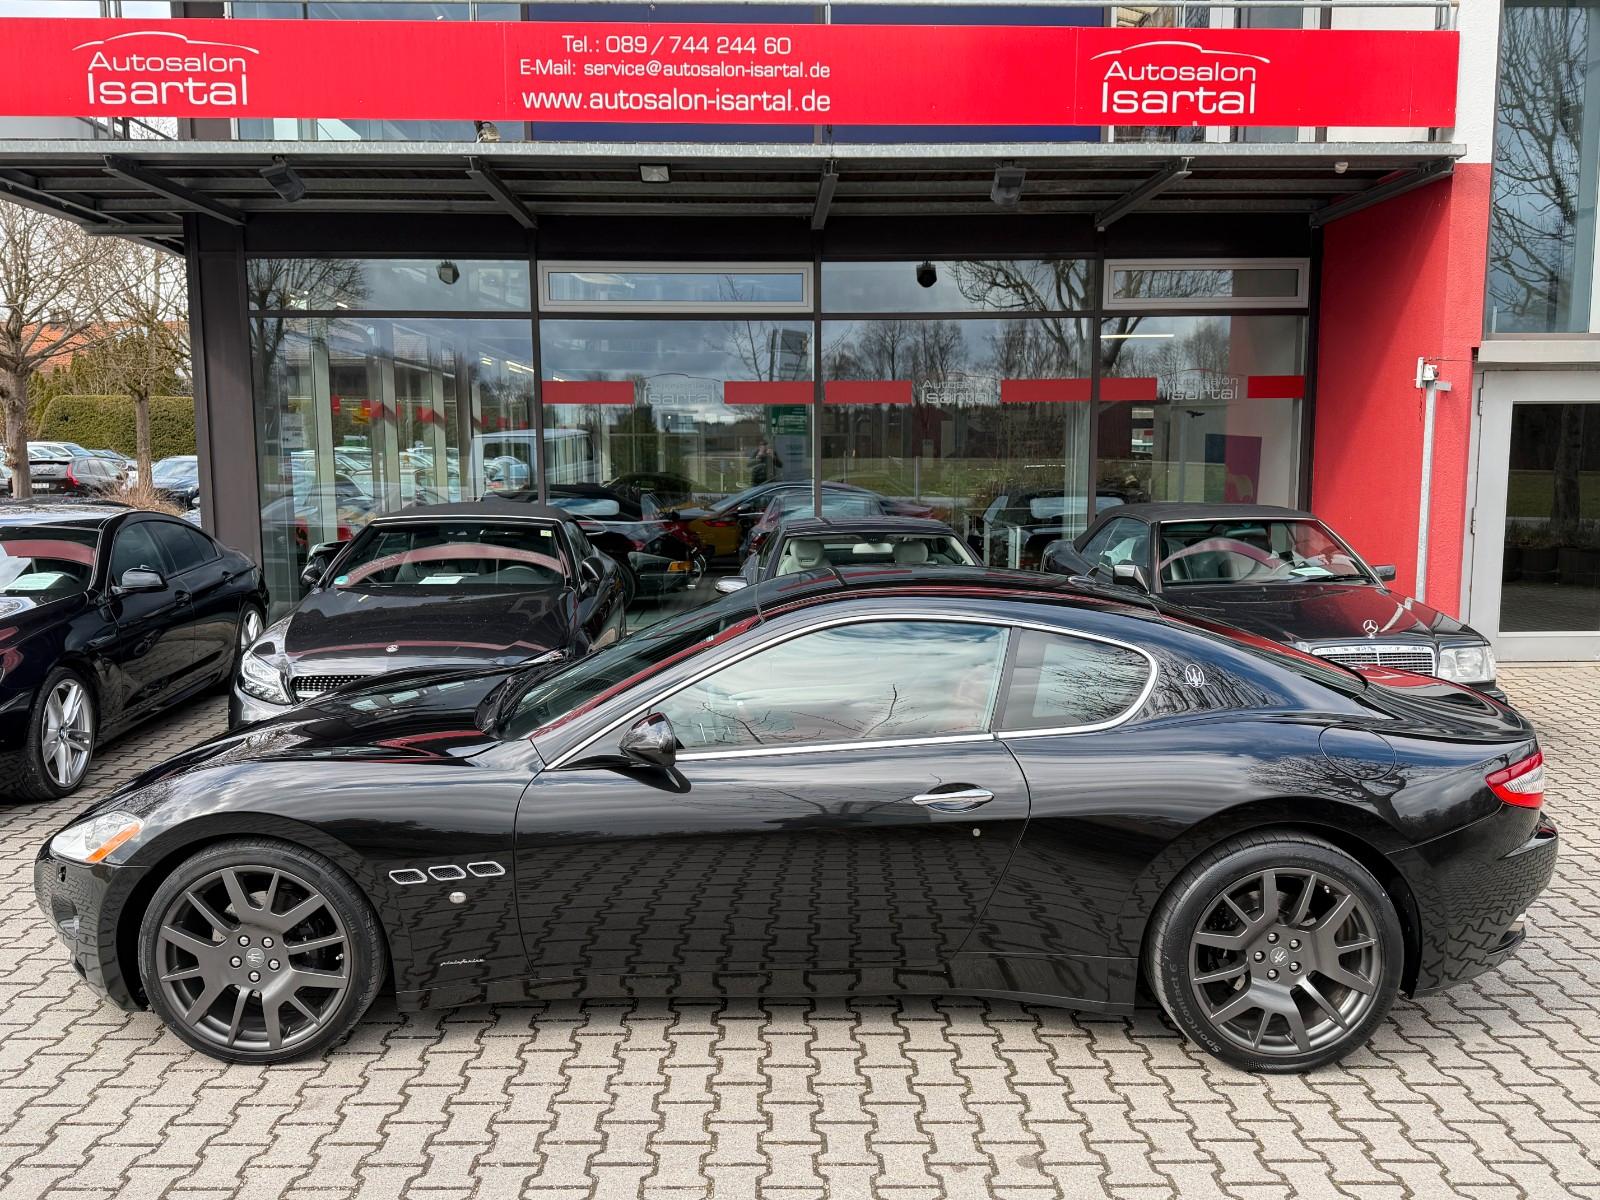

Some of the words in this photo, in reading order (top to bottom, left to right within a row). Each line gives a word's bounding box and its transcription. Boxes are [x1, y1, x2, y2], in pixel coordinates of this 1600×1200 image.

[562, 35, 600, 53] Tel.:
[605, 35, 648, 53] 089
[669, 36, 709, 54] 744
[716, 36, 757, 54] 244
[764, 36, 791, 55] 60
[88, 51, 246, 72] Autosalon
[519, 59, 577, 76] E-Mail:
[584, 60, 830, 79] service@autosalon-isartal.de
[1104, 60, 1257, 82] Autosalon
[87, 73, 248, 105] Isartal
[521, 87, 831, 112] www.autosalon-isartal.de
[1101, 82, 1256, 114] Isartal
[644, 390, 714, 405] Isartal
[922, 389, 992, 404] Isartal
